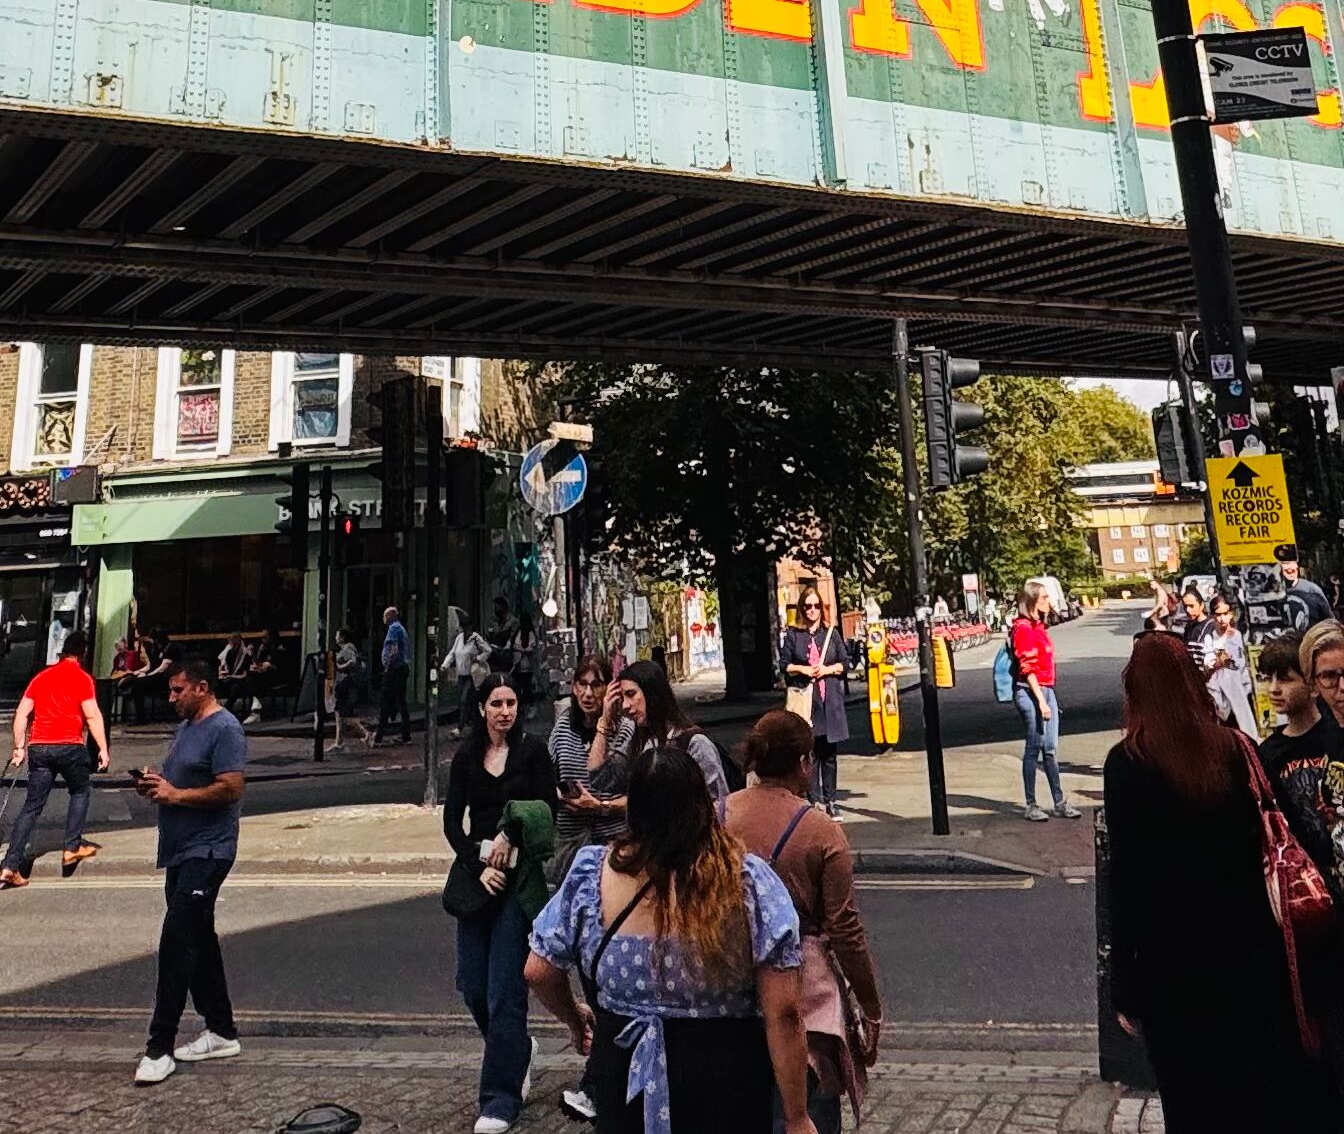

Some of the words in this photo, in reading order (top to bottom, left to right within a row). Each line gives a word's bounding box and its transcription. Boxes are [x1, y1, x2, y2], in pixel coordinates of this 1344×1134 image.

[1254, 43, 1304, 60] CCTV
[1221, 484, 1275, 501] KOZMIC
[1219, 498, 1283, 514] RECORDS
[1225, 511, 1280, 527] RECORD
[1239, 524, 1270, 539] FAIR
